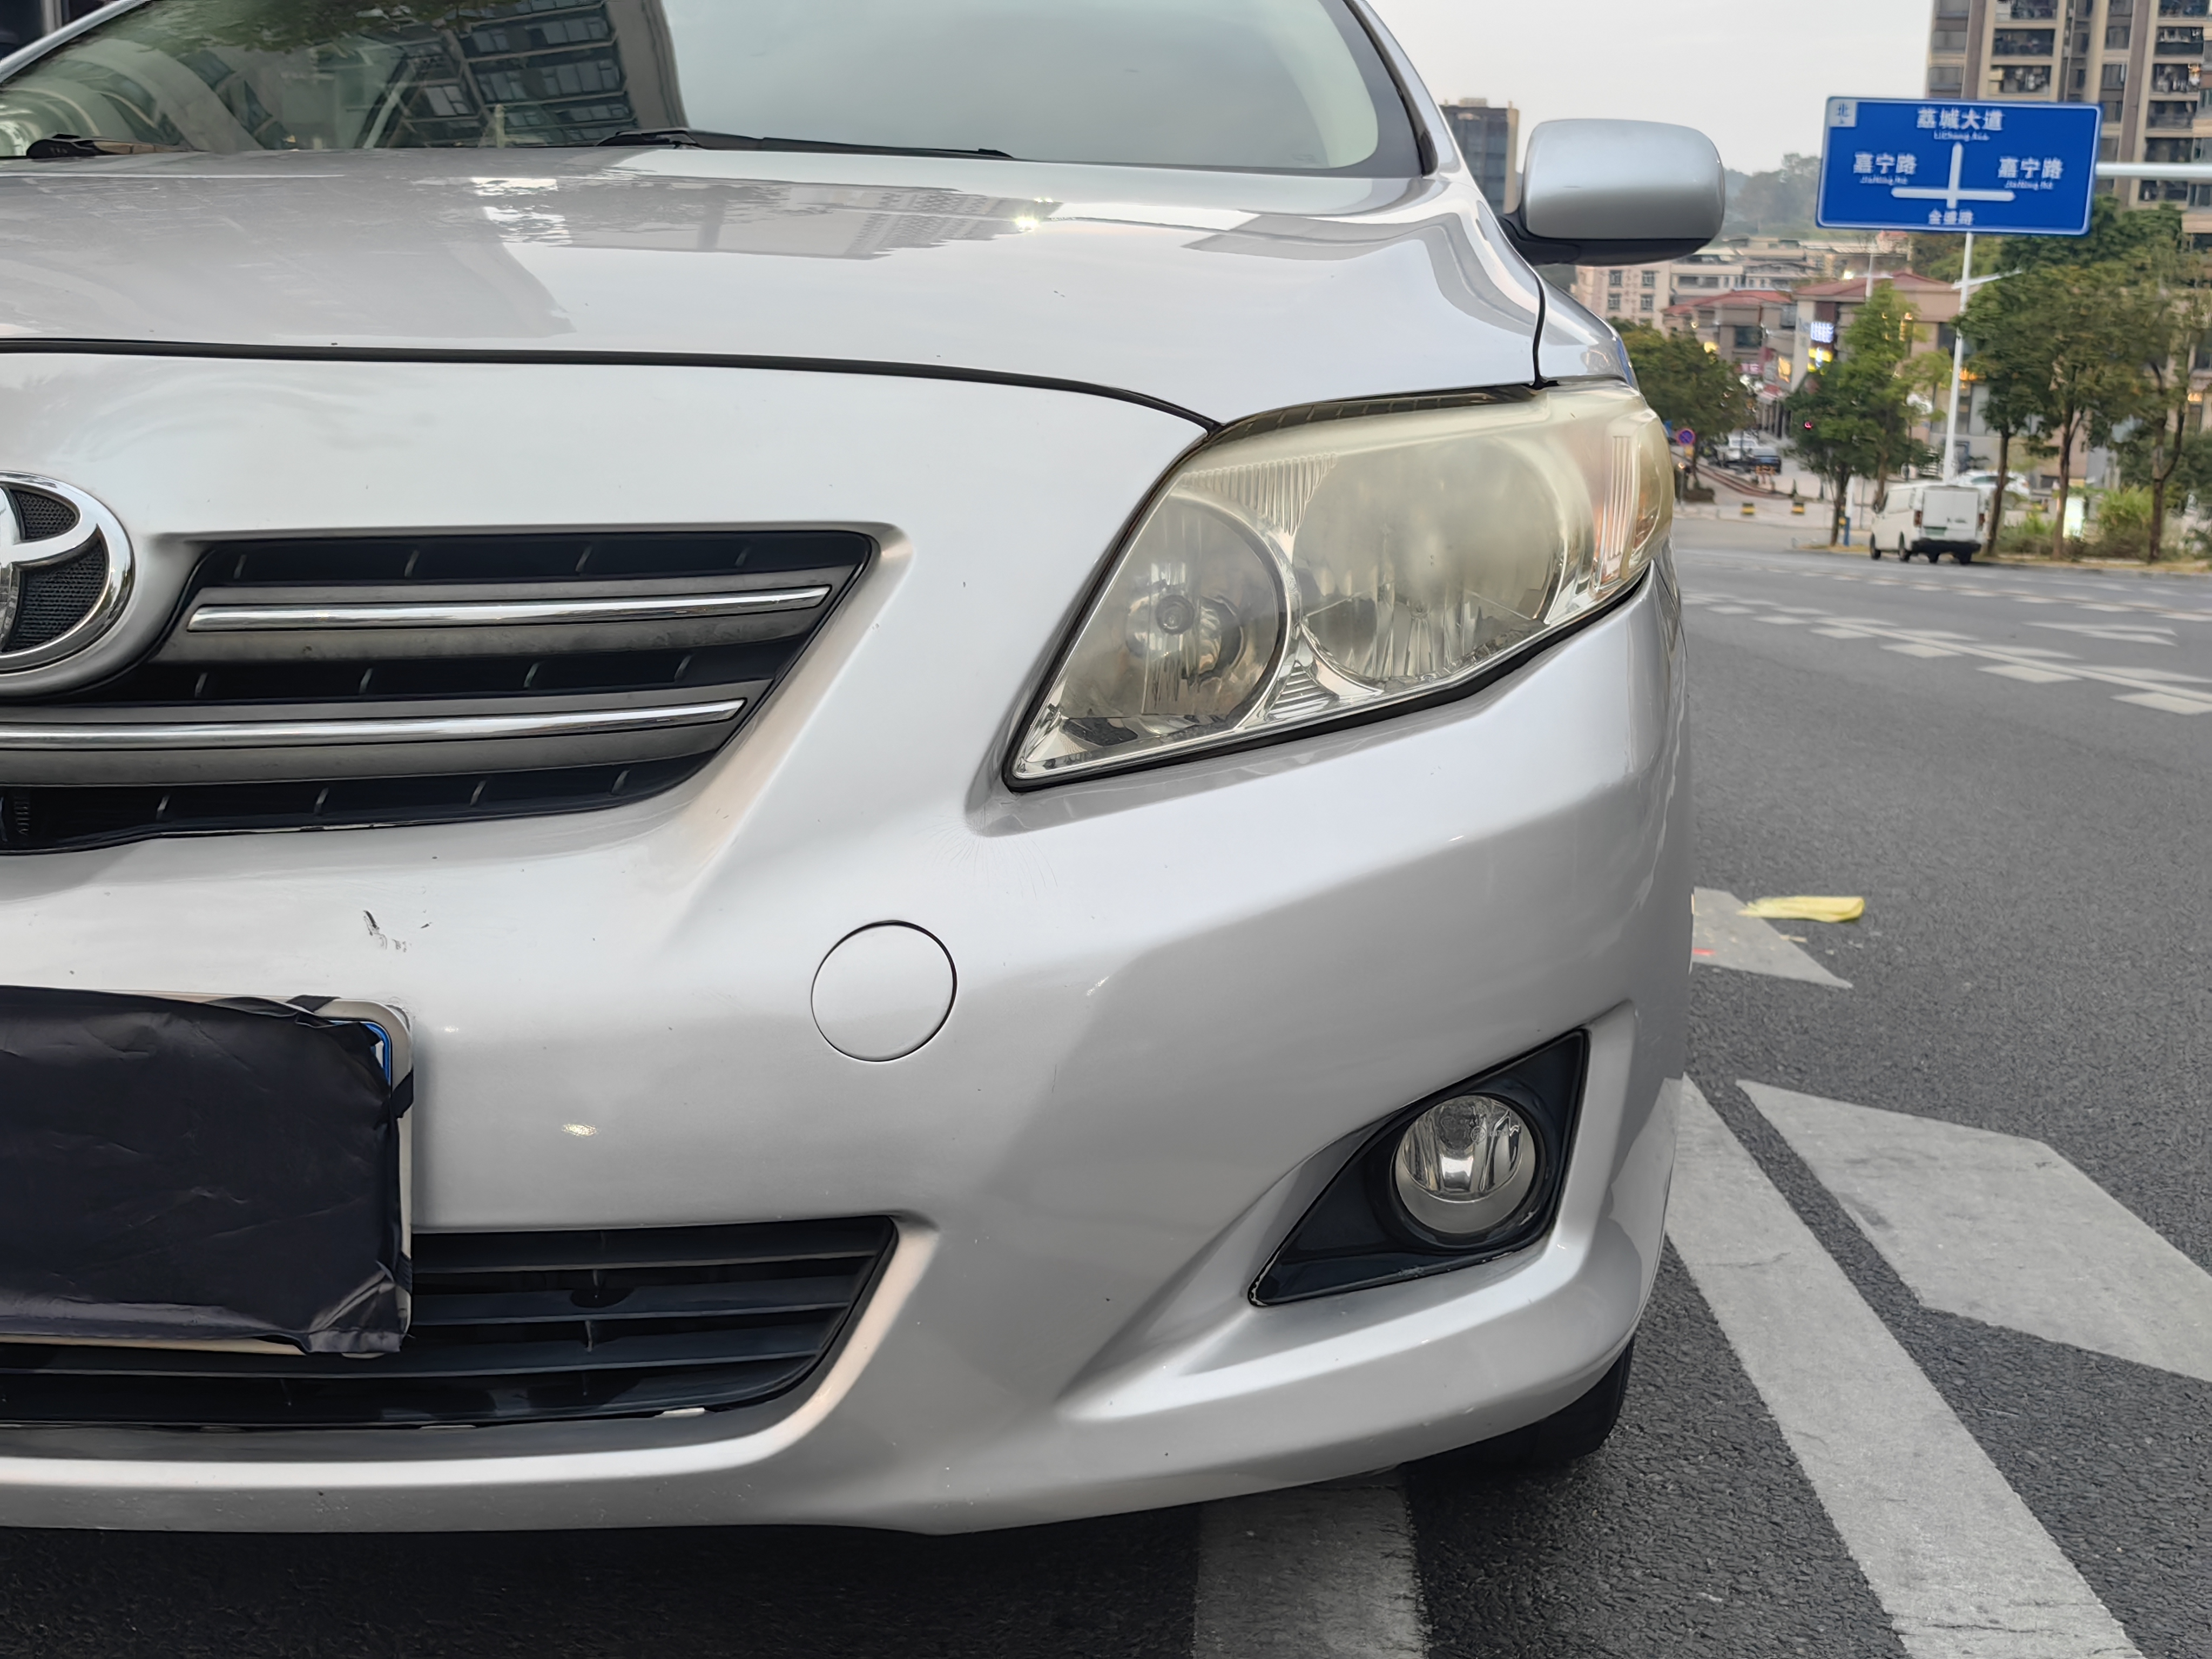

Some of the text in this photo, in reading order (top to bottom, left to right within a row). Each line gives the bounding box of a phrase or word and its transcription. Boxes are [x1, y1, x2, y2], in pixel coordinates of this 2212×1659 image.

[1917, 107, 2003, 130] 荔城大道
[1853, 152, 1917, 175] 嘉宁路
[1998, 157, 2063, 179] 嘉宁路
